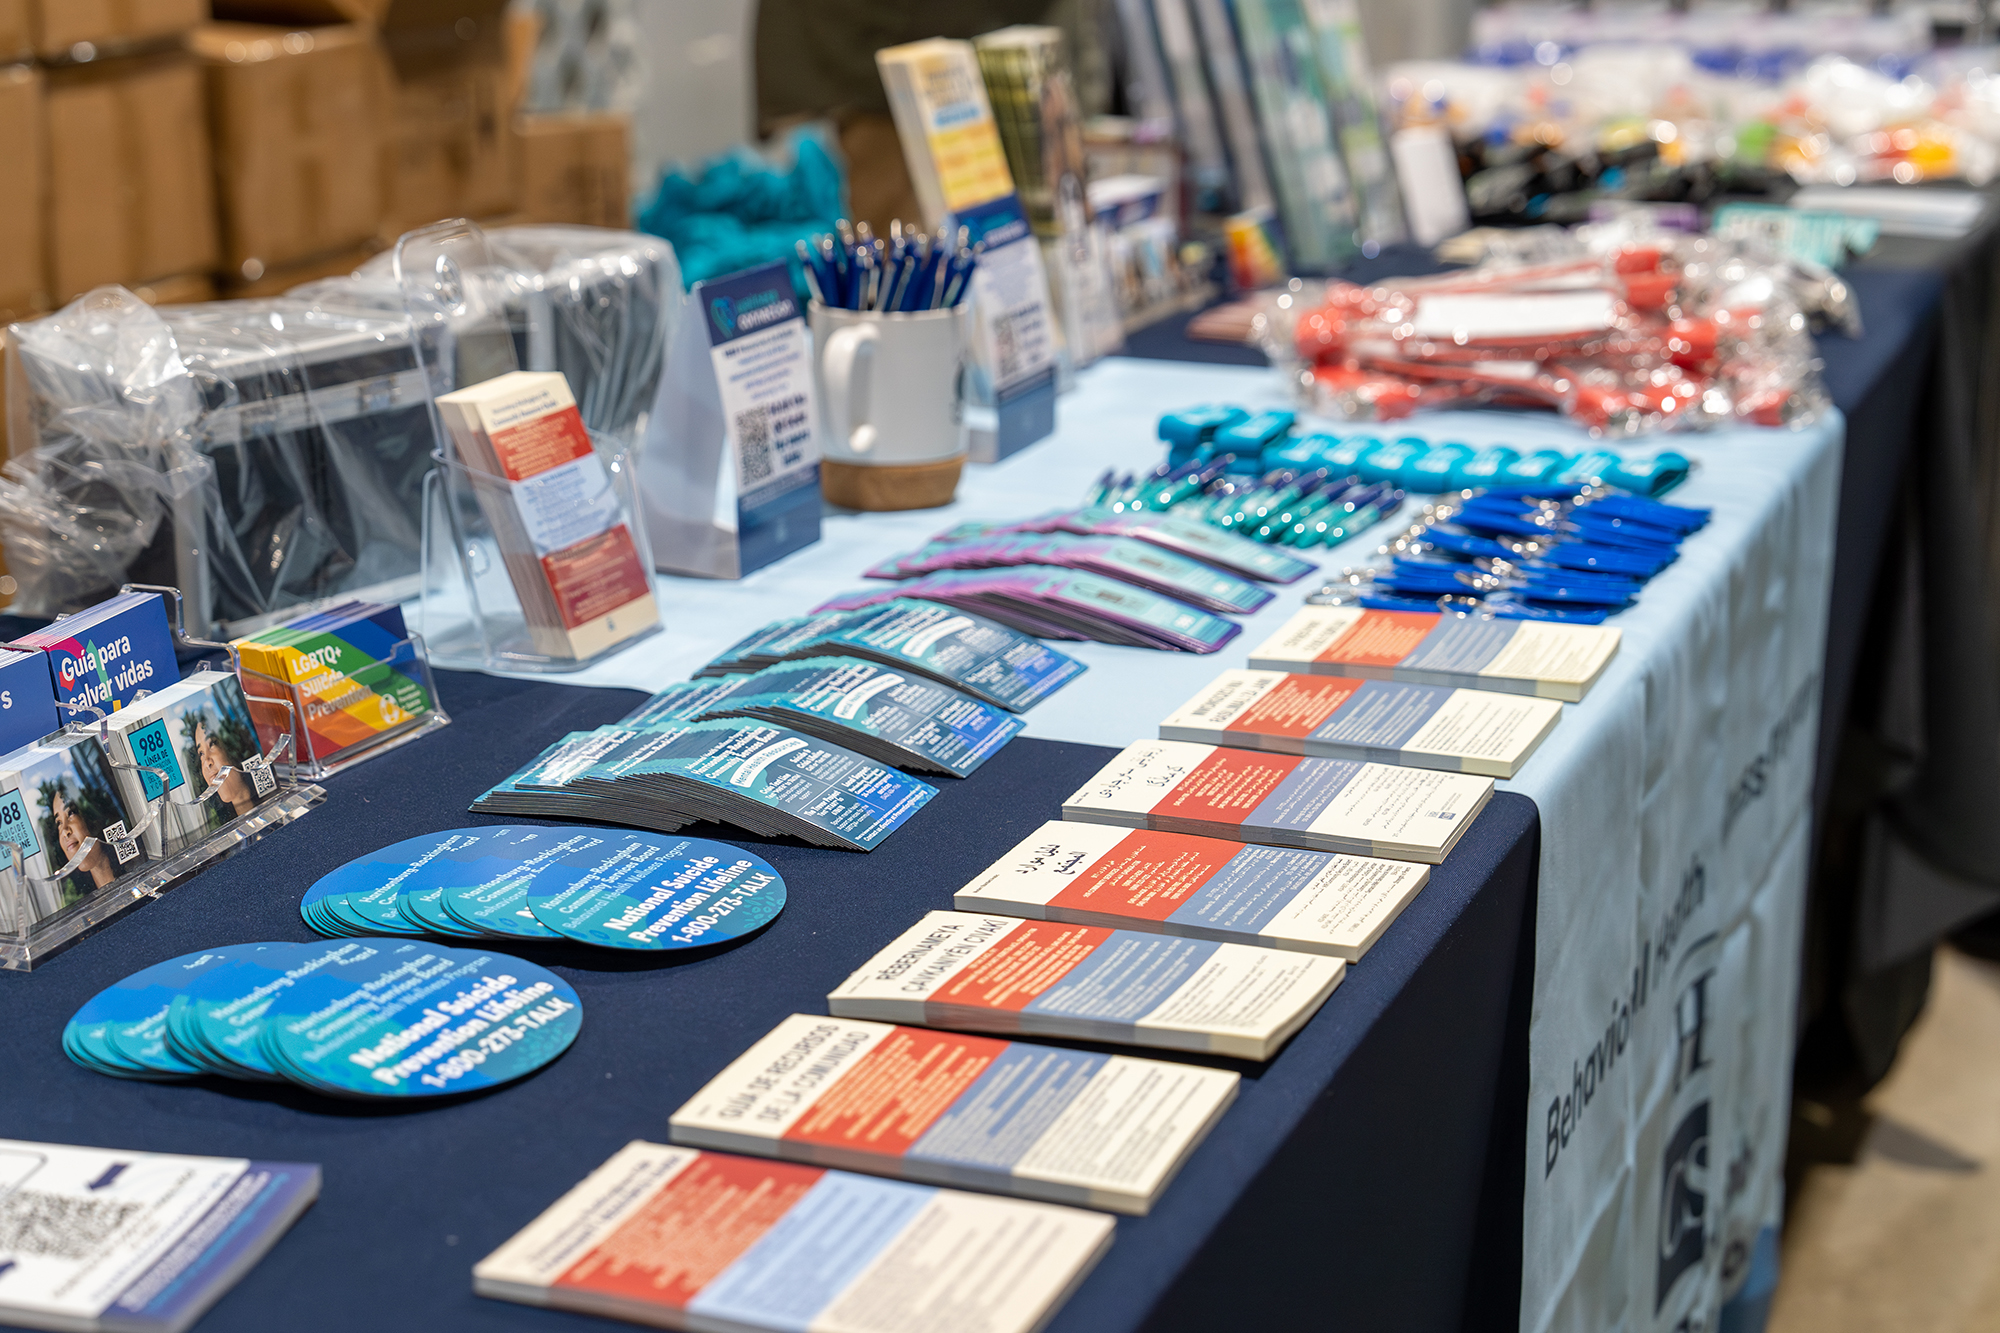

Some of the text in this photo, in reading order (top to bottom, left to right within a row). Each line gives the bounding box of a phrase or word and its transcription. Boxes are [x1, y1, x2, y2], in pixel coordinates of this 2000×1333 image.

[61, 636, 132, 682] Guía para
[68, 659, 154, 716] salvar vidas
[292, 645, 342, 676] LGBTQ+
[307, 684, 374, 721] Prevention
[139, 730, 164, 756] 988
[144, 752, 161, 767] LÍNEA
[161, 749, 169, 760] DE
[0, 802, 21, 828] 88
[459, 833, 587, 899] Harrisonburg-Rockingham
[540, 841, 643, 910] Harrisonburg-Rockingham
[559, 845, 661, 914] Community Services Board
[562, 839, 692, 930] Behavioral Health Wellness Program
[603, 855, 720, 931] National Suicide
[628, 859, 753, 943] Prevention Lifeline
[672, 871, 776, 943] 1-800-273-TALK
[306, 957, 455, 1041] Community Services Board
[442, 955, 493, 980] Program
[349, 974, 518, 1070] National Suicide
[371, 981, 554, 1087] Prevention Lifeline
[421, 996, 575, 1088] 1-800-273-TALK
